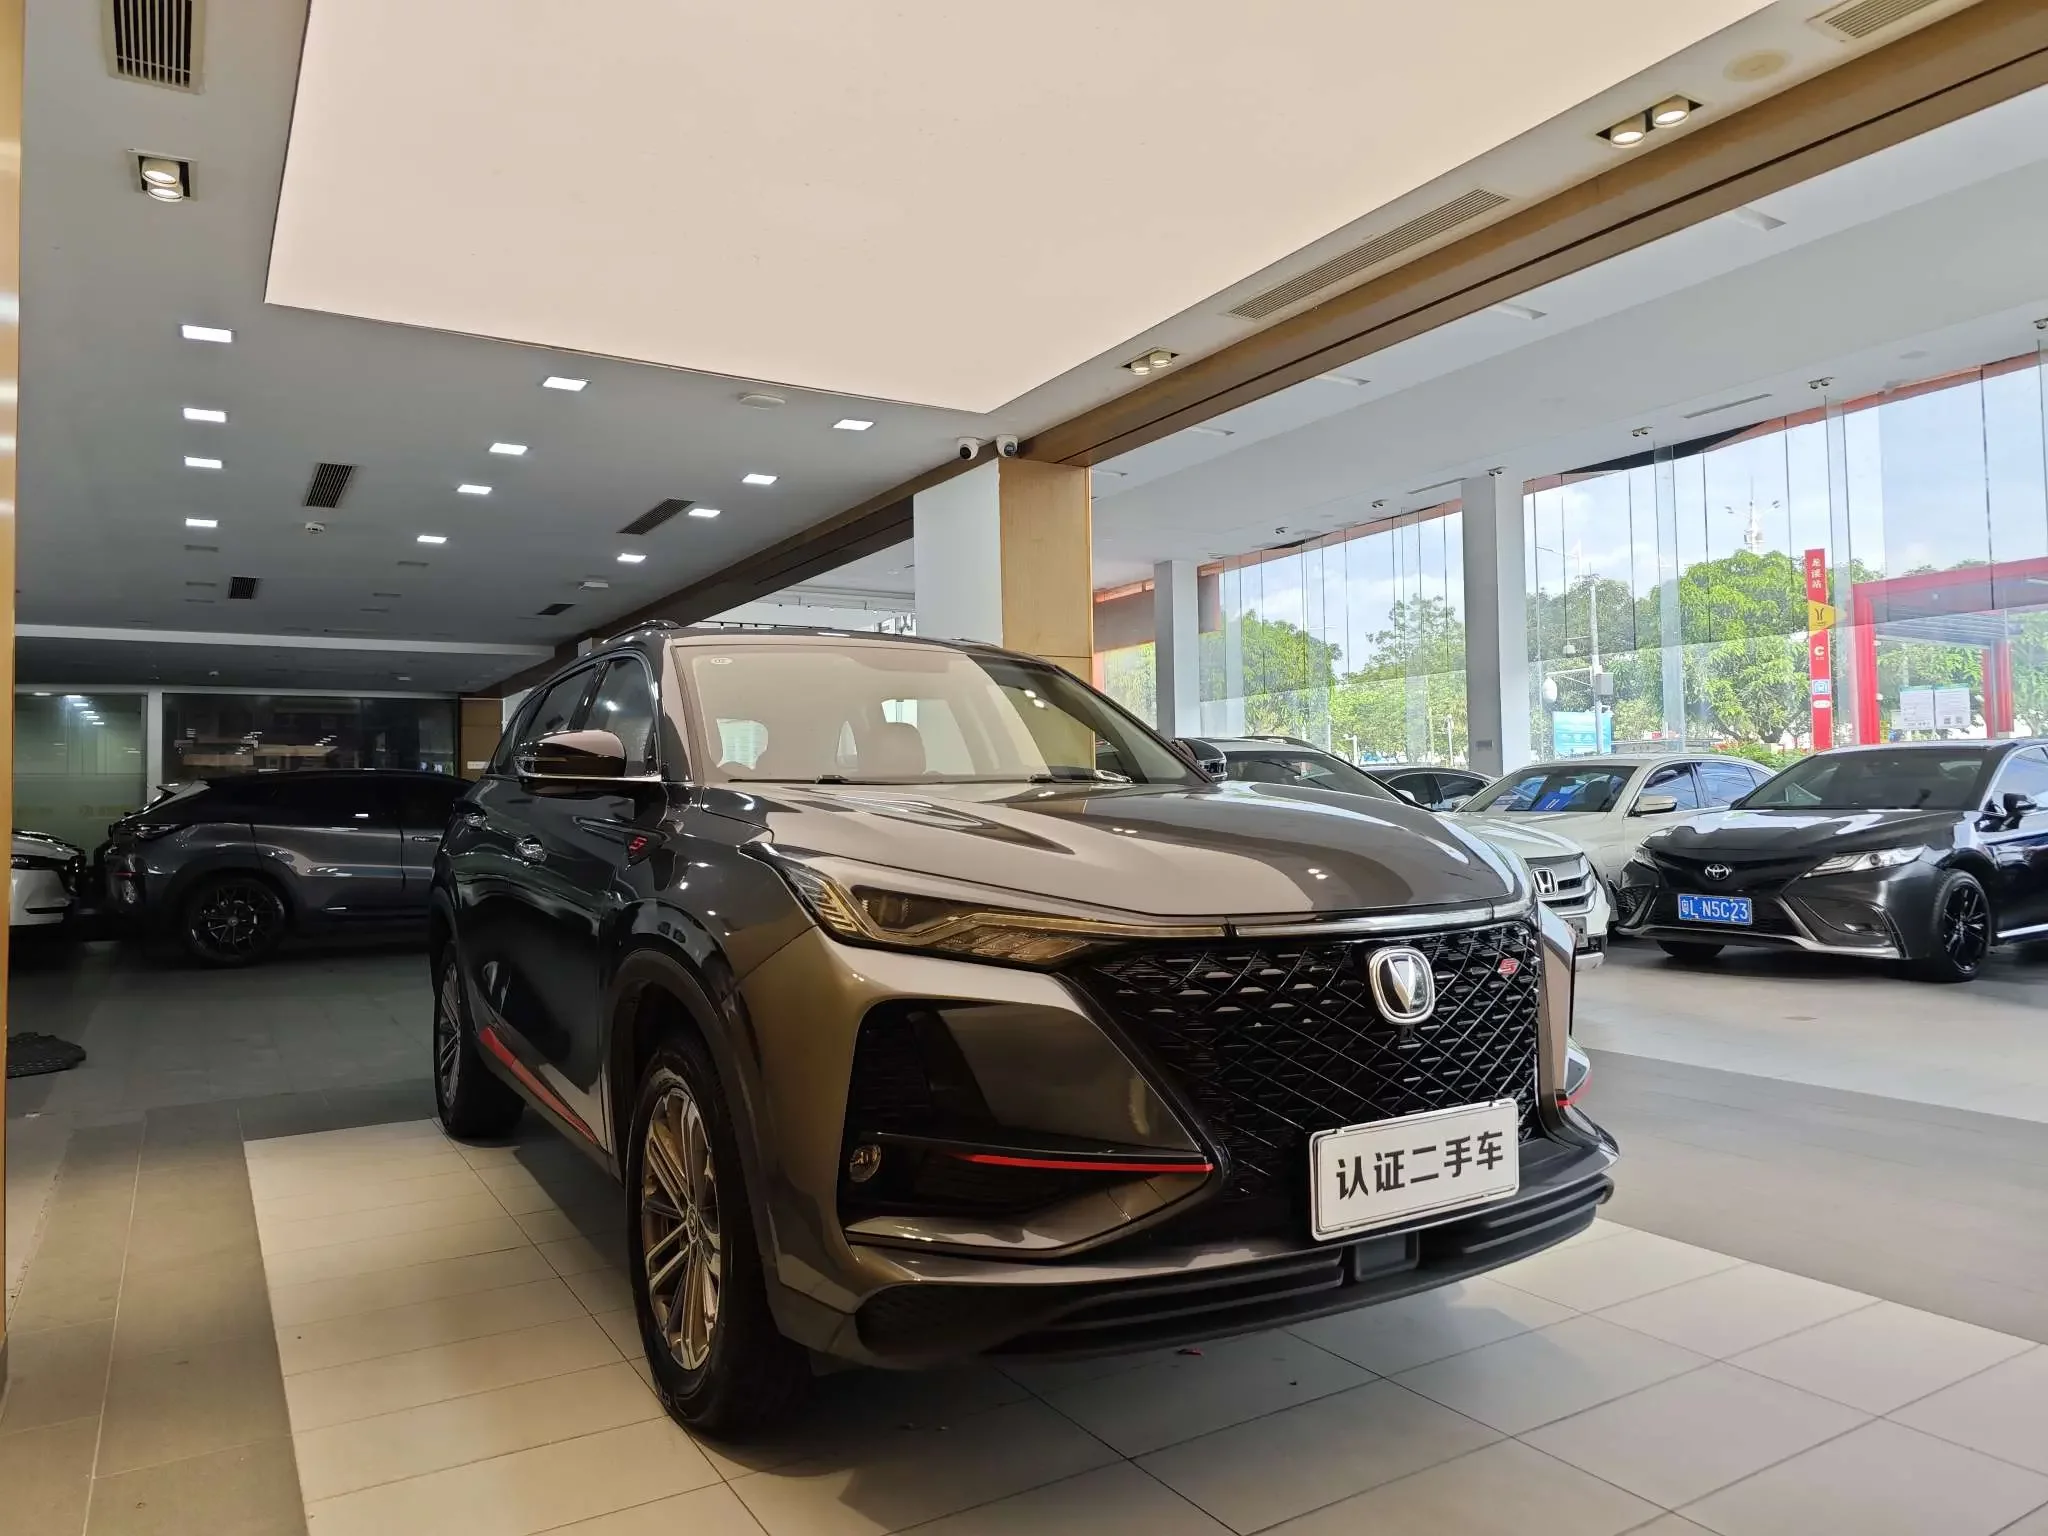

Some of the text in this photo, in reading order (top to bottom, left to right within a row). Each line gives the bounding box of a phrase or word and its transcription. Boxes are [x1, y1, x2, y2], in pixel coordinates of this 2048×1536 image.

[1814, 645, 1825, 656] C
[1336, 1131, 1503, 1199] 认证二手车
